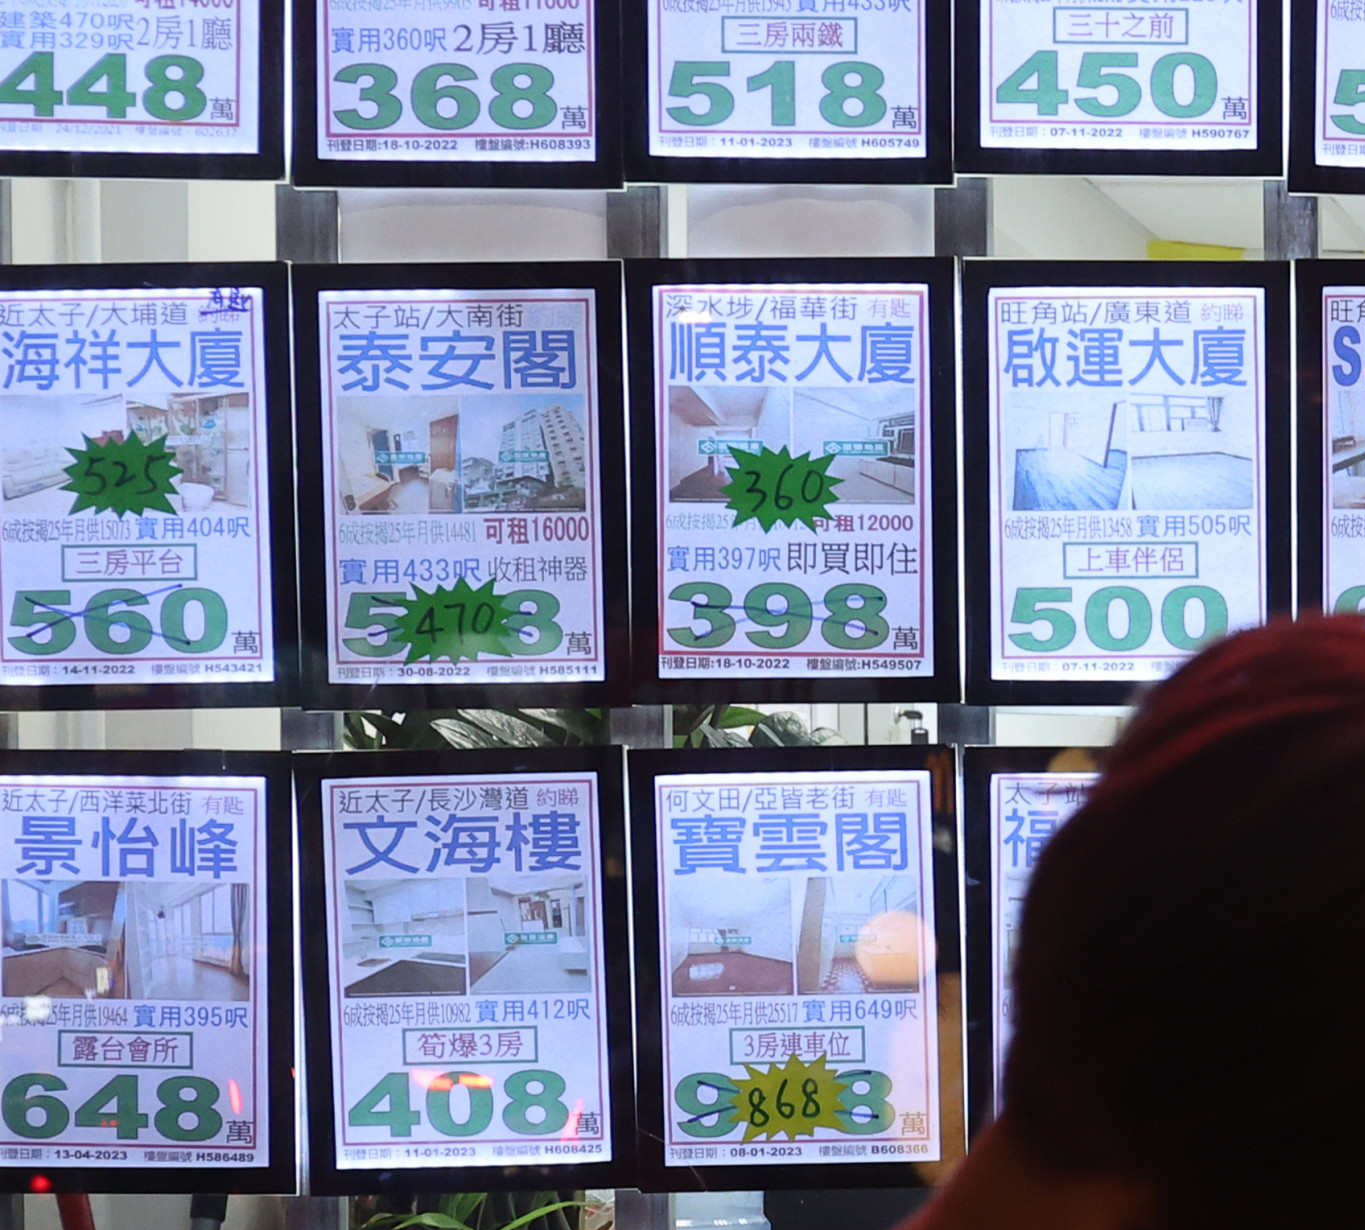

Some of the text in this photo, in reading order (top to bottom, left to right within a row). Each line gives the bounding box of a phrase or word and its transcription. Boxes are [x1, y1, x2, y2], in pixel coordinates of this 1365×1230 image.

[736, 21, 843, 48] 三房兩鐵
[0, 302, 188, 327] 近太子/大埔道
[333, 305, 523, 329] 太子站/大南街
[1001, 302, 1191, 326] 旺角站/廣東道
[3, 330, 245, 391] 海祥大廈
[338, 331, 575, 391] 泰安閣
[669, 323, 915, 384] 順泰大廈
[85, 452, 168, 495] 525
[745, 471, 826, 508] 360
[76, 550, 184, 575] 三房平台
[1078, 547, 1183, 573] 上車伴侶
[415, 605, 495, 643] 470
[15, 816, 239, 878] 景怡峰
[344, 811, 581, 874] 文海樓
[673, 813, 908, 874] 寶雲閣
[72, 1036, 178, 1063] 露台會所
